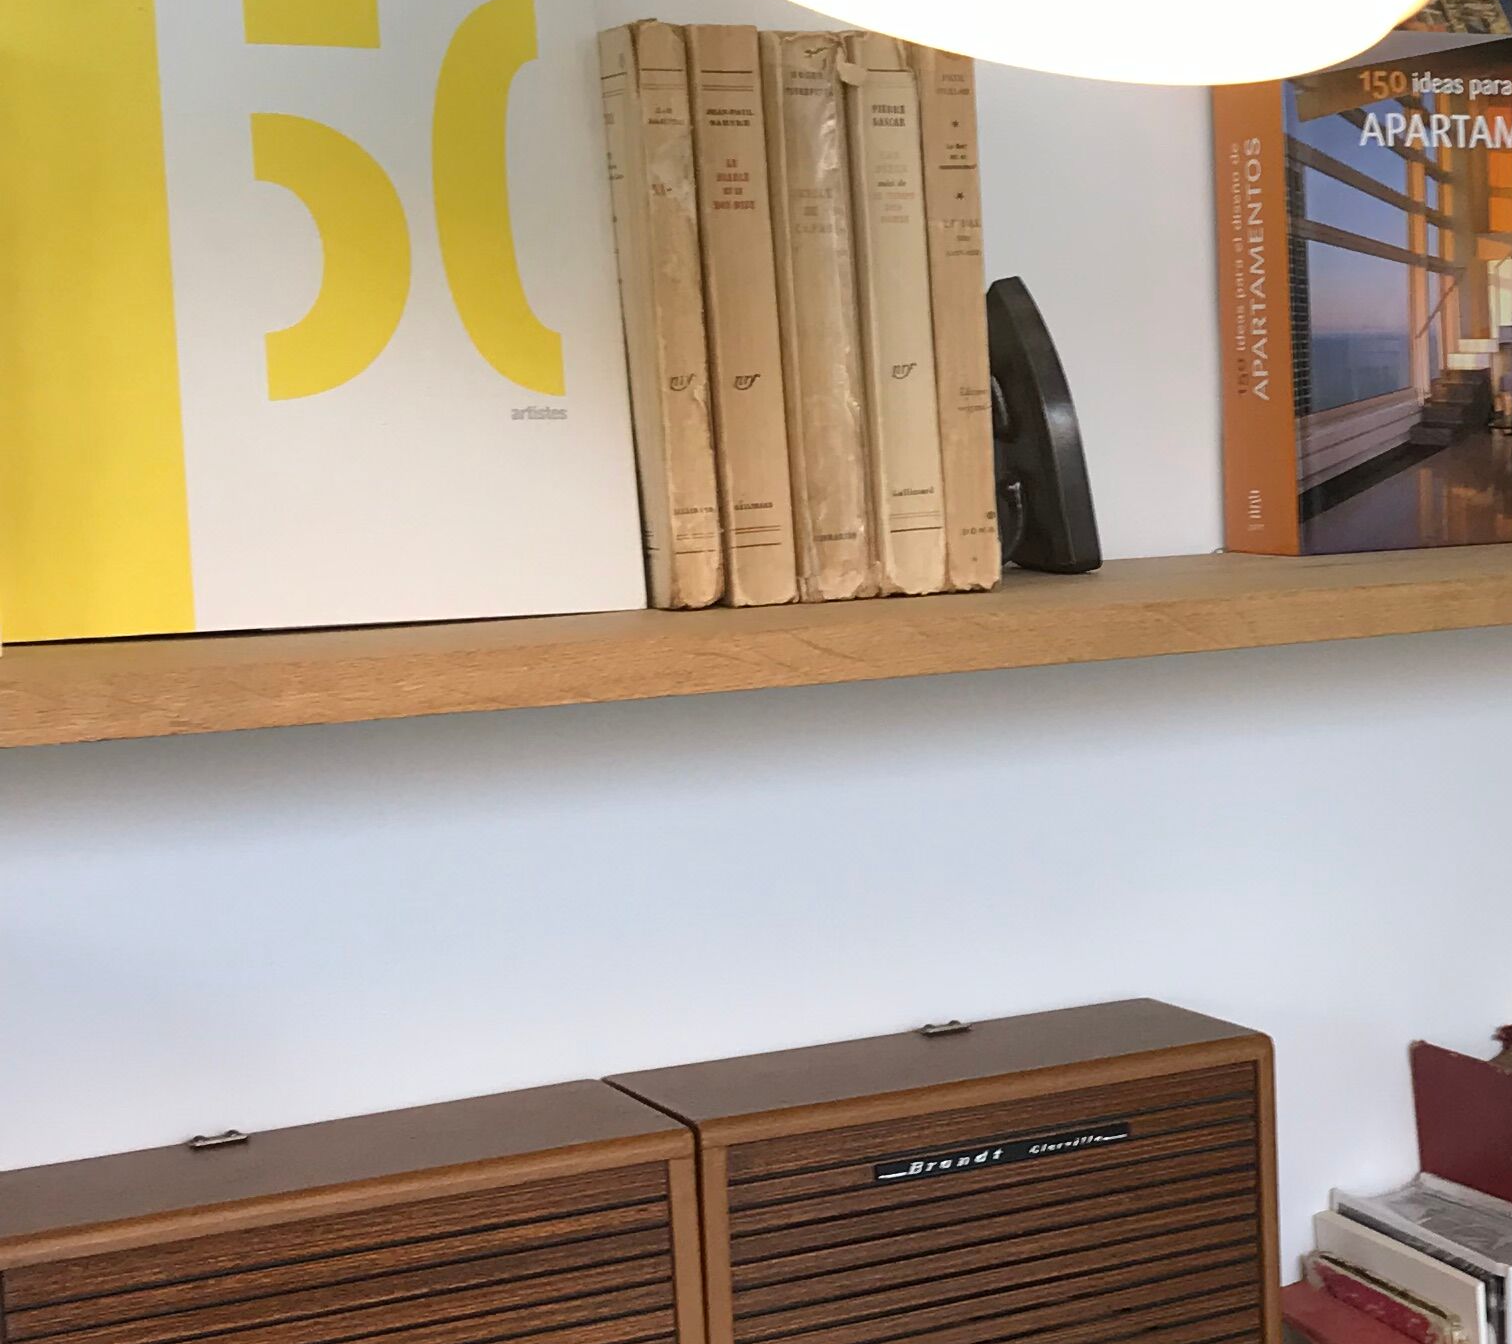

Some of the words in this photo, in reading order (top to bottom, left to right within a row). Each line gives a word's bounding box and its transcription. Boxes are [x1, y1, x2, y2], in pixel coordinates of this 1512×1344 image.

[1358, 69, 1408, 99] 150
[1411, 71, 1464, 95] ideas
[1229, 142, 1240, 163] de
[1229, 172, 1243, 231] diseño
[1234, 237, 1244, 254] el
[1234, 260, 1247, 300] para
[1244, 136, 1271, 402] APARTAMENTOS
[1235, 319, 1247, 352] ideas
[1236, 357, 1246, 396] 150
[511, 405, 568, 420] artistes
[907, 1148, 1004, 1175] Brandt
